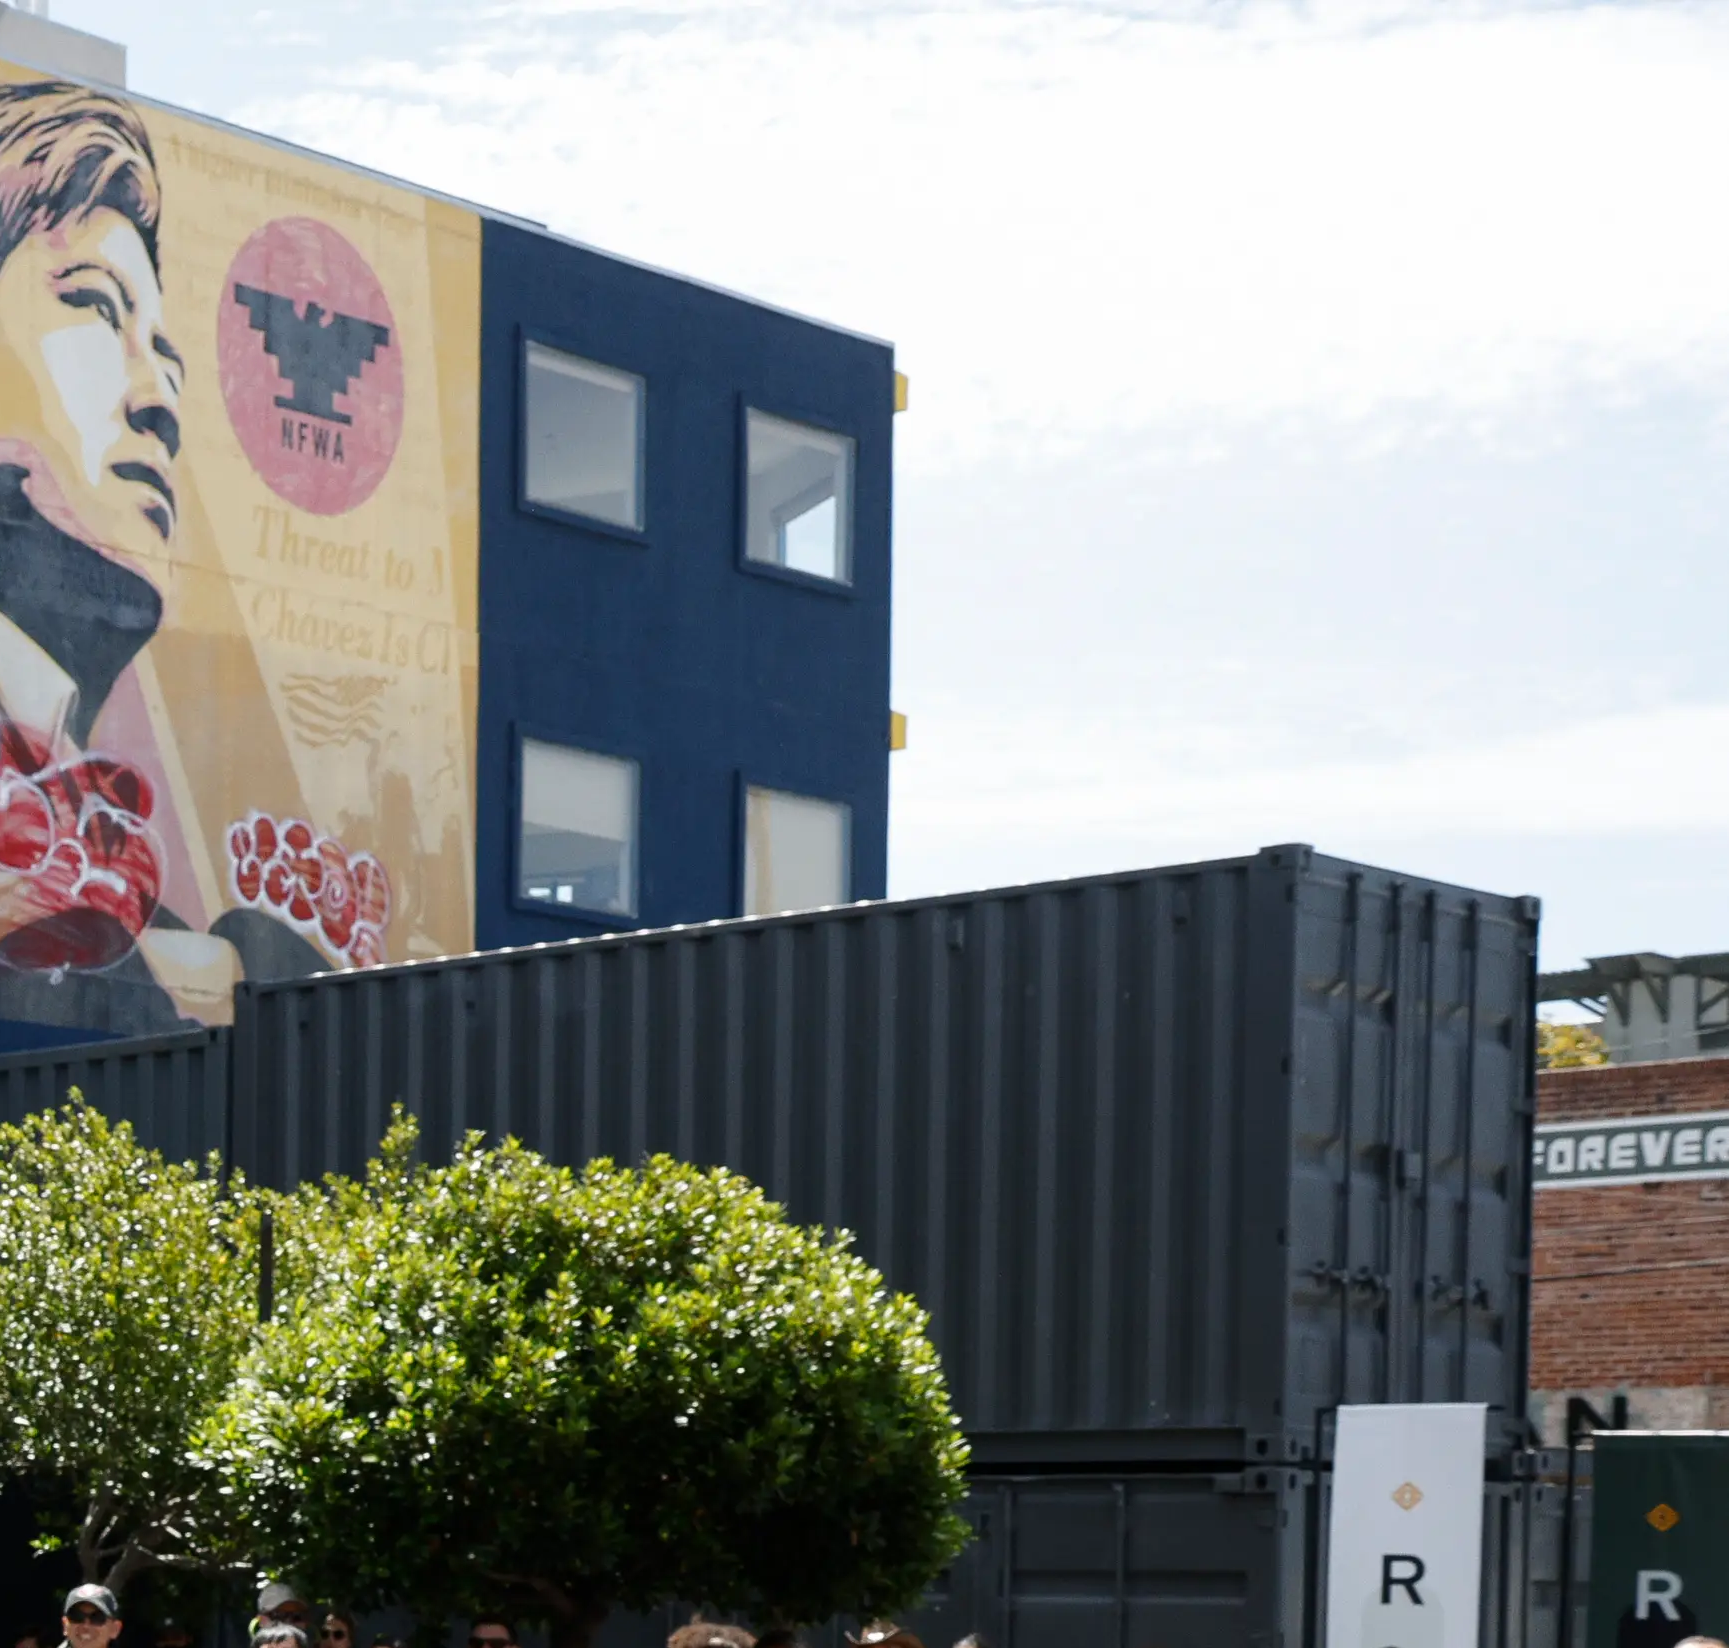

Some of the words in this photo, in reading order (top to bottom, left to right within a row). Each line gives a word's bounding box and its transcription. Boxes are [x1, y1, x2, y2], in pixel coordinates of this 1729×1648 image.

[281, 417, 346, 464] NFWA
[252, 503, 370, 581] Threat
[384, 547, 415, 591] to
[1380, 1553, 1425, 1606] R
